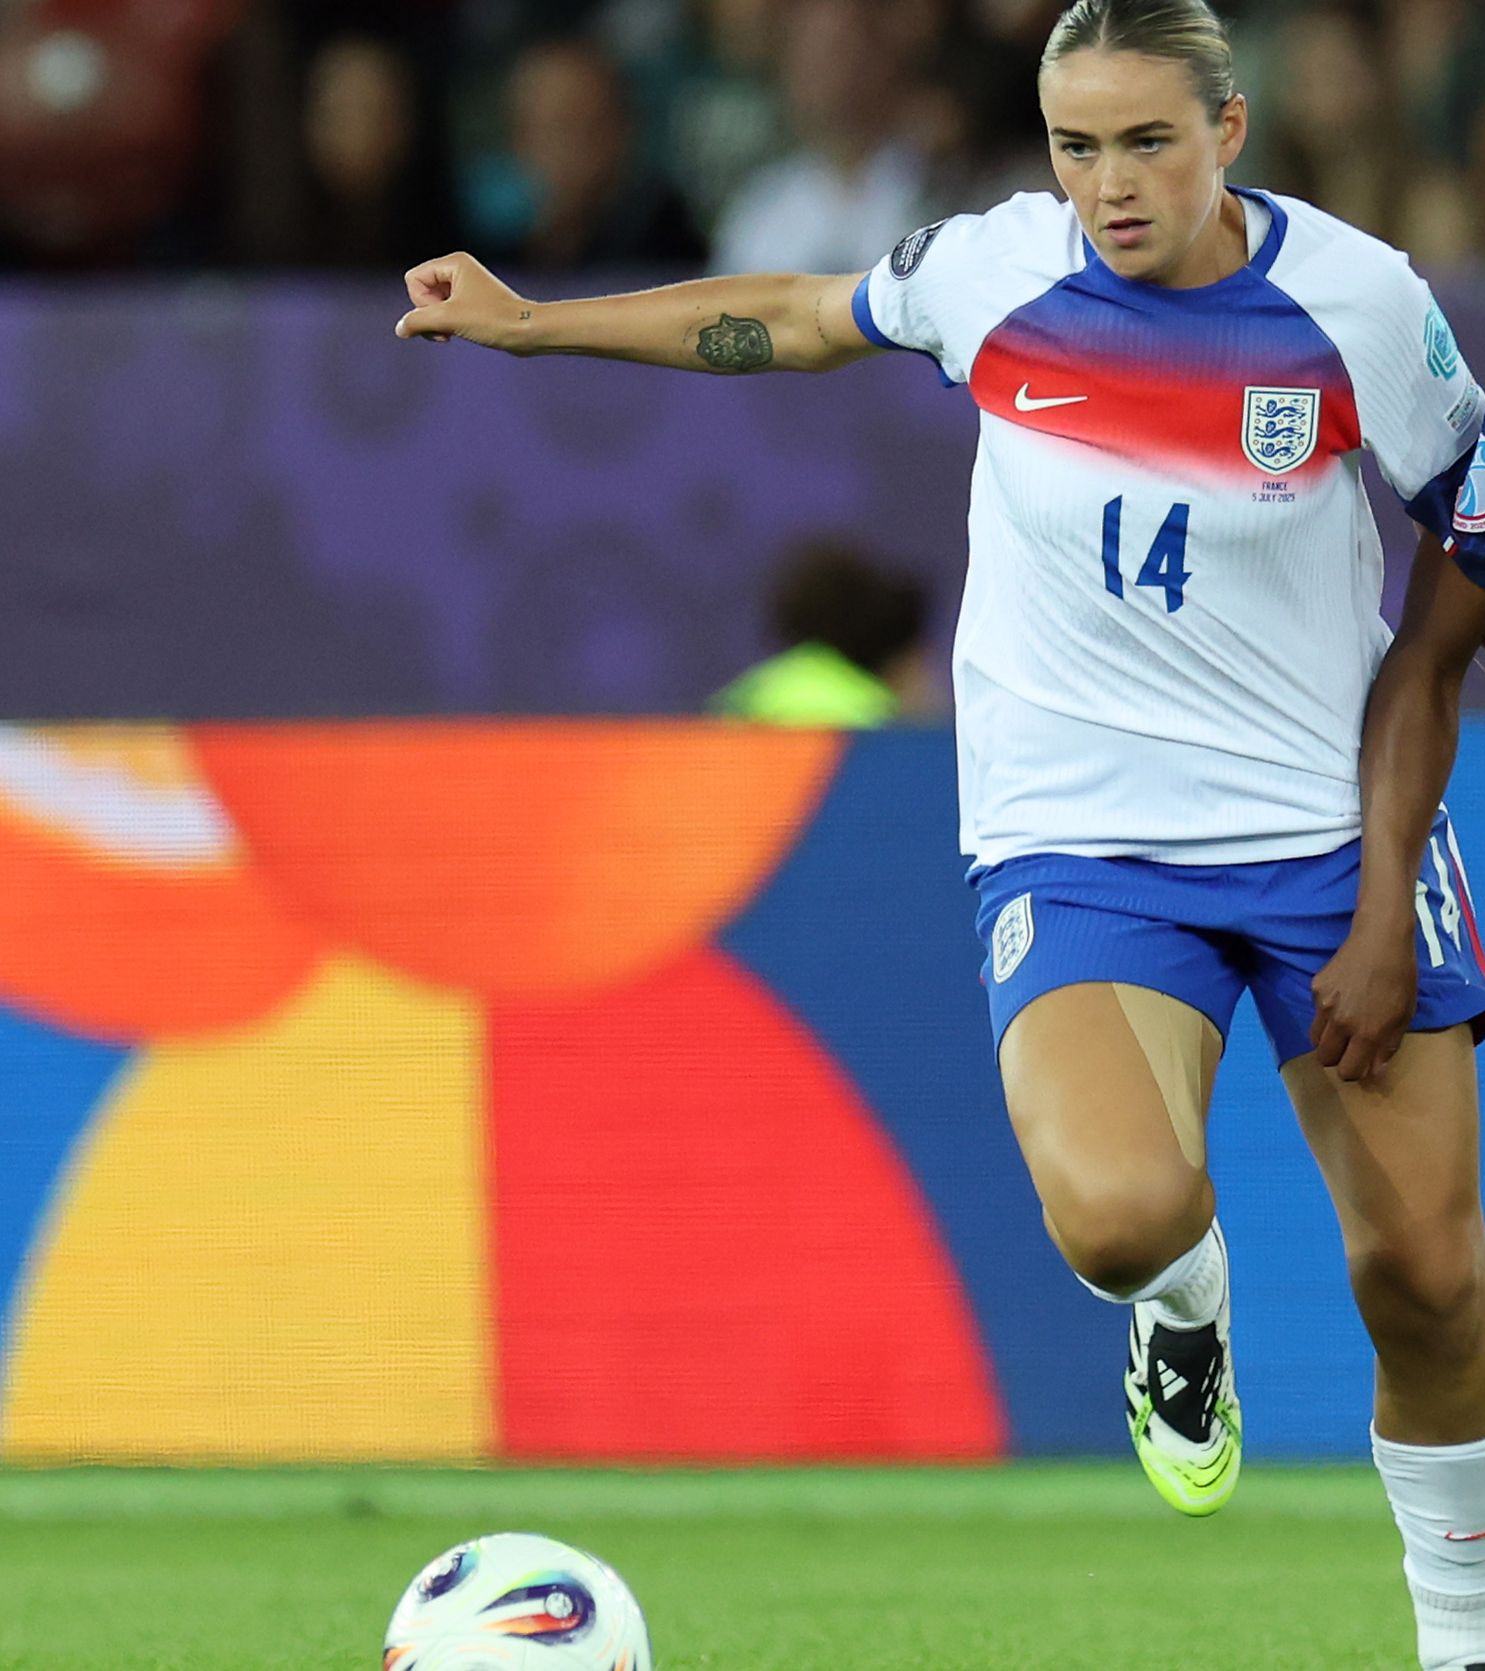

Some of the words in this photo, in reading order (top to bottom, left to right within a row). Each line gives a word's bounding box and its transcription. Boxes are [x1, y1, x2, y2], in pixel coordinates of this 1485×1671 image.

[1262, 481, 1287, 491] FRANCE
[1251, 493, 1257, 502] 5
[1258, 493, 1276, 502] JULY
[1102, 494, 1193, 614] 14
